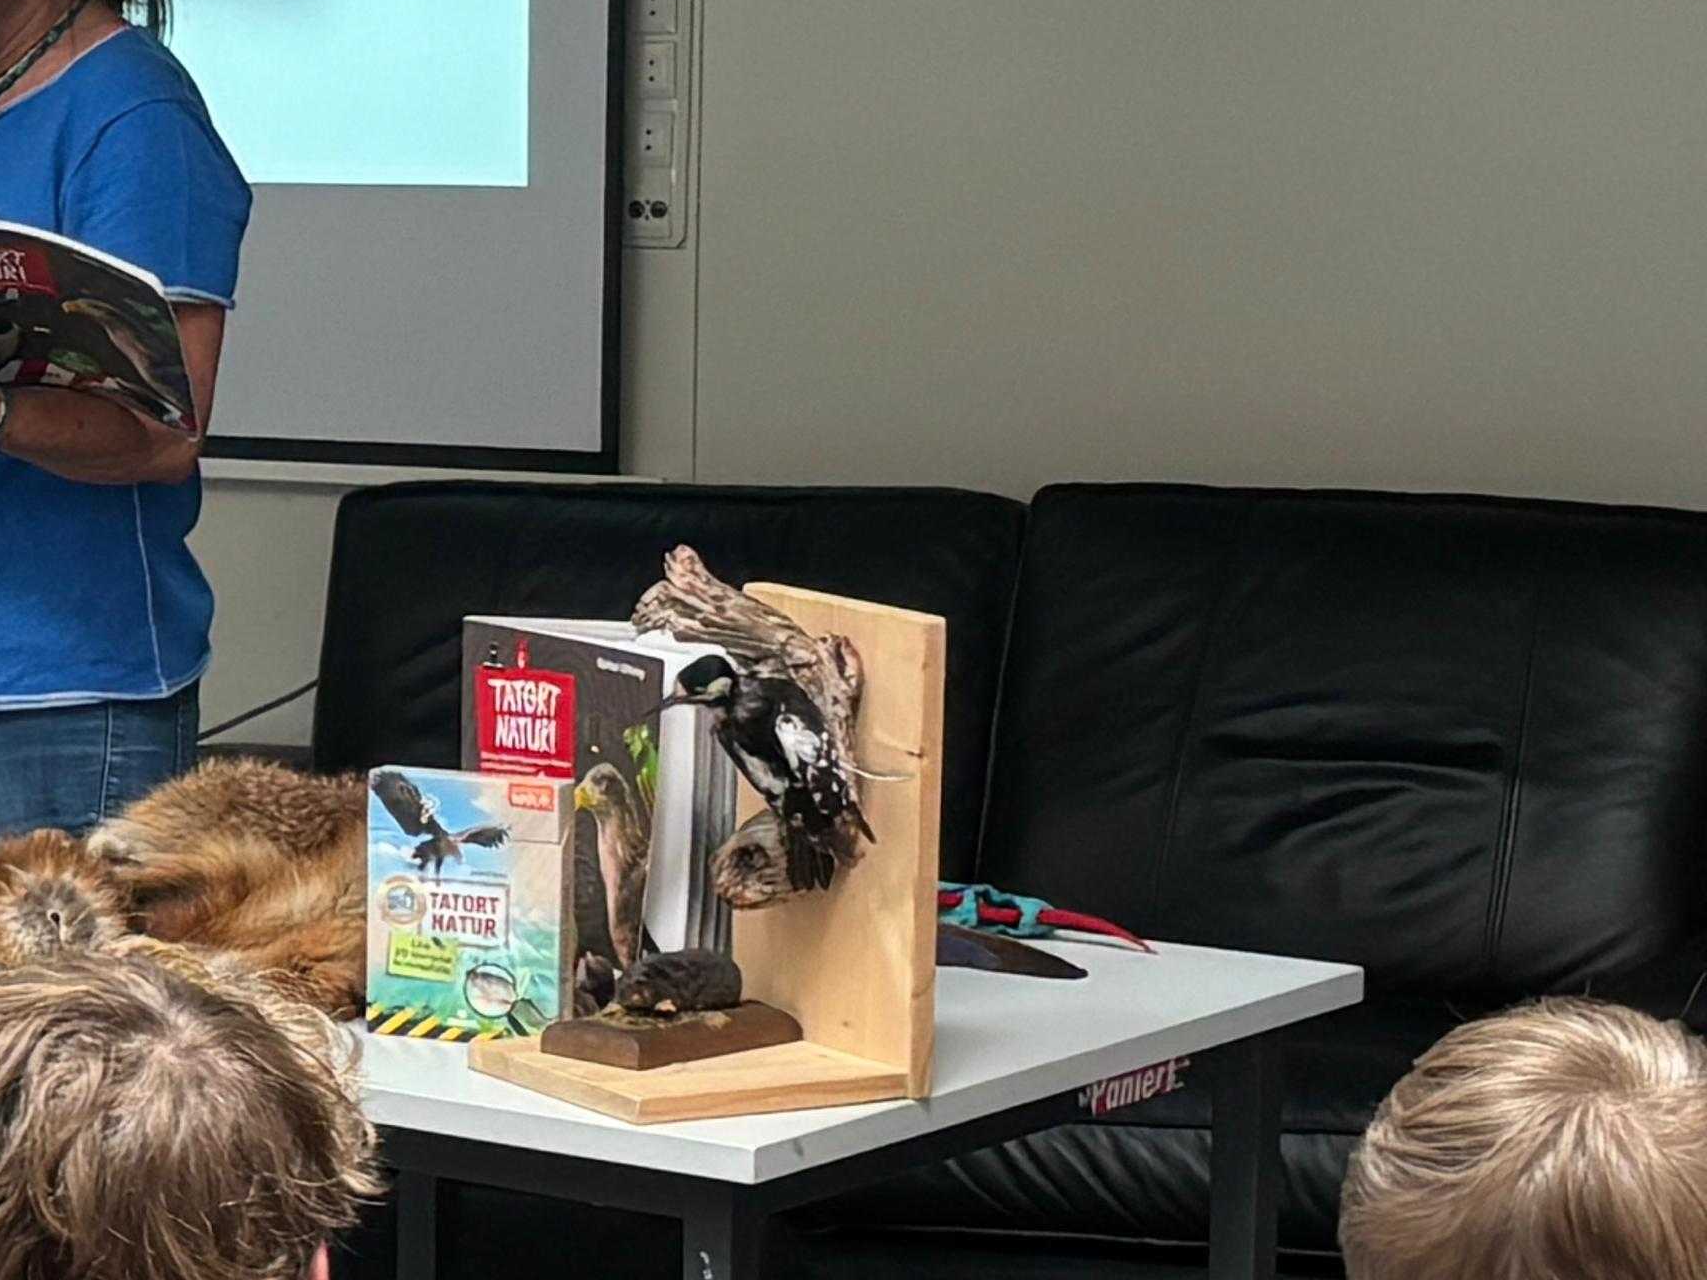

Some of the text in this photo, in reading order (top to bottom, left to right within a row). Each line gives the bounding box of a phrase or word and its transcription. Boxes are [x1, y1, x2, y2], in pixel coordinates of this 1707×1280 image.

[487, 678, 562, 717] TATORT
[429, 891, 500, 914] TATORT
[430, 915, 499, 938] NATUR
